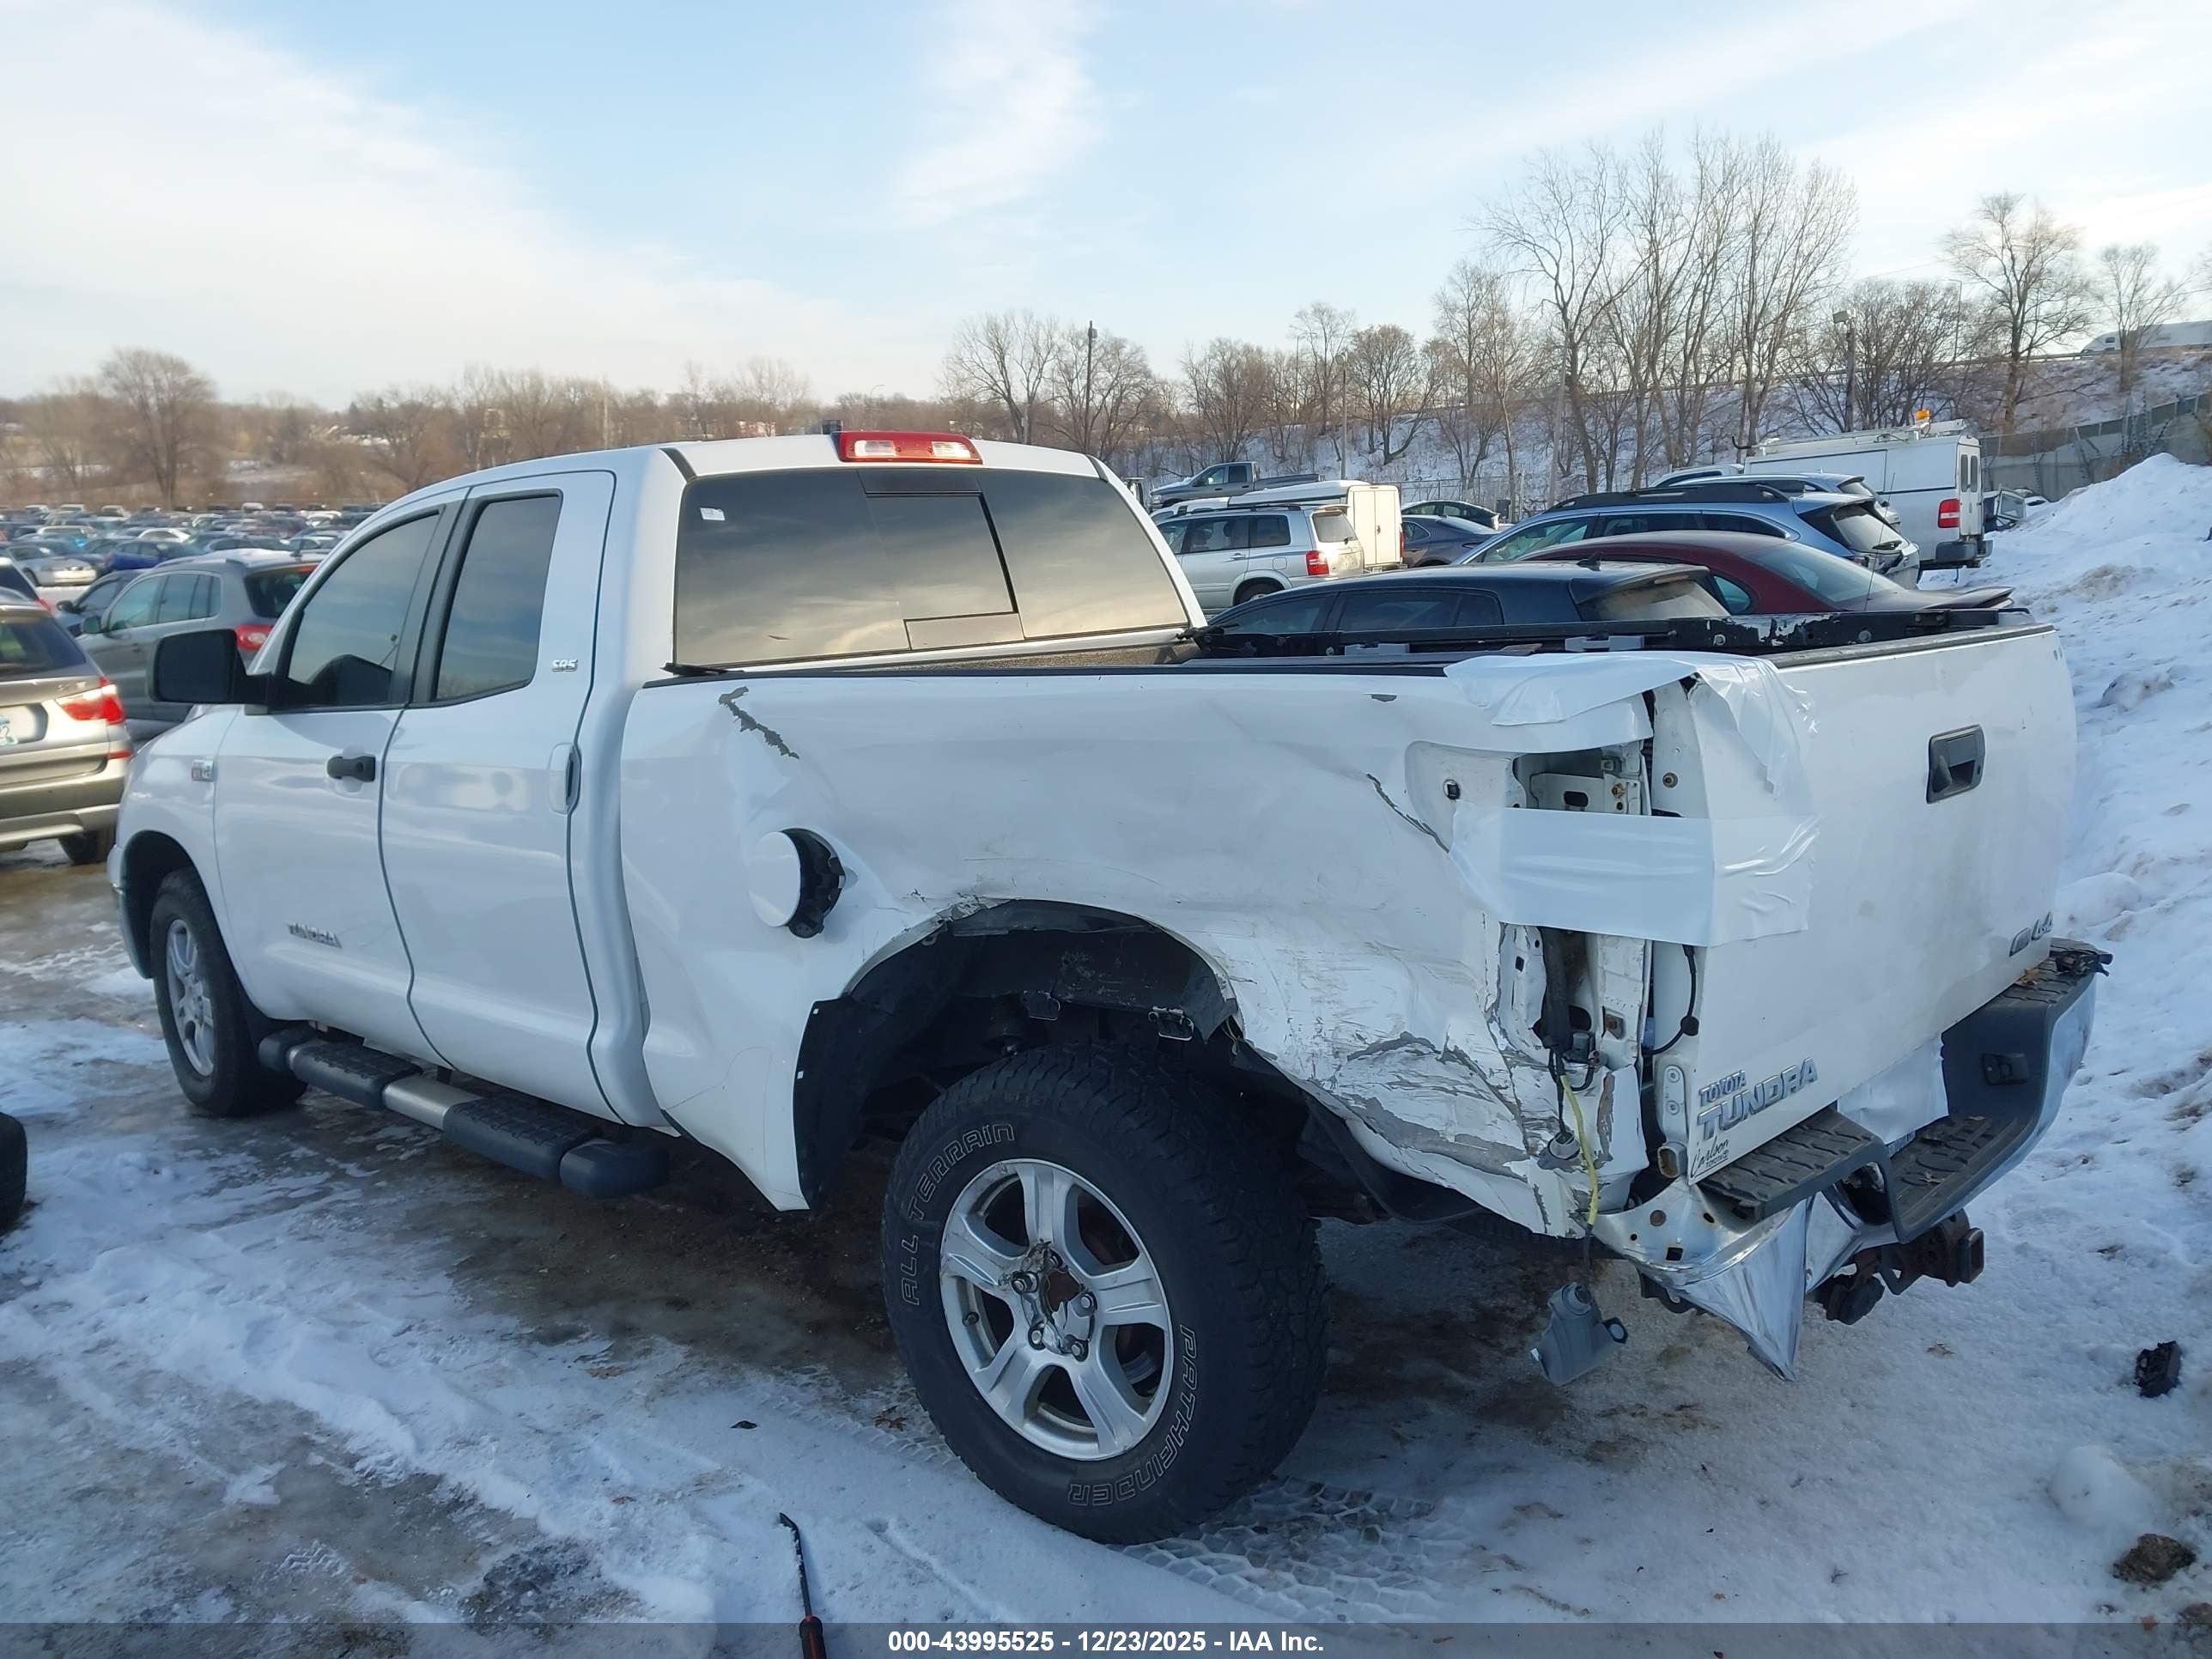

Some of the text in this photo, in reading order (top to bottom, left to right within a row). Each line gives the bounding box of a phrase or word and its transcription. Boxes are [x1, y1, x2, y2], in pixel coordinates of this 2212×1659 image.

[552, 659, 578, 672] SR5
[1697, 1057, 1818, 1141] TUNDRA
[1698, 1069, 1747, 1107] TOYOTA
[901, 1234, 920, 1306] ALL
[1067, 1323, 1198, 1506] PATHFINDER
